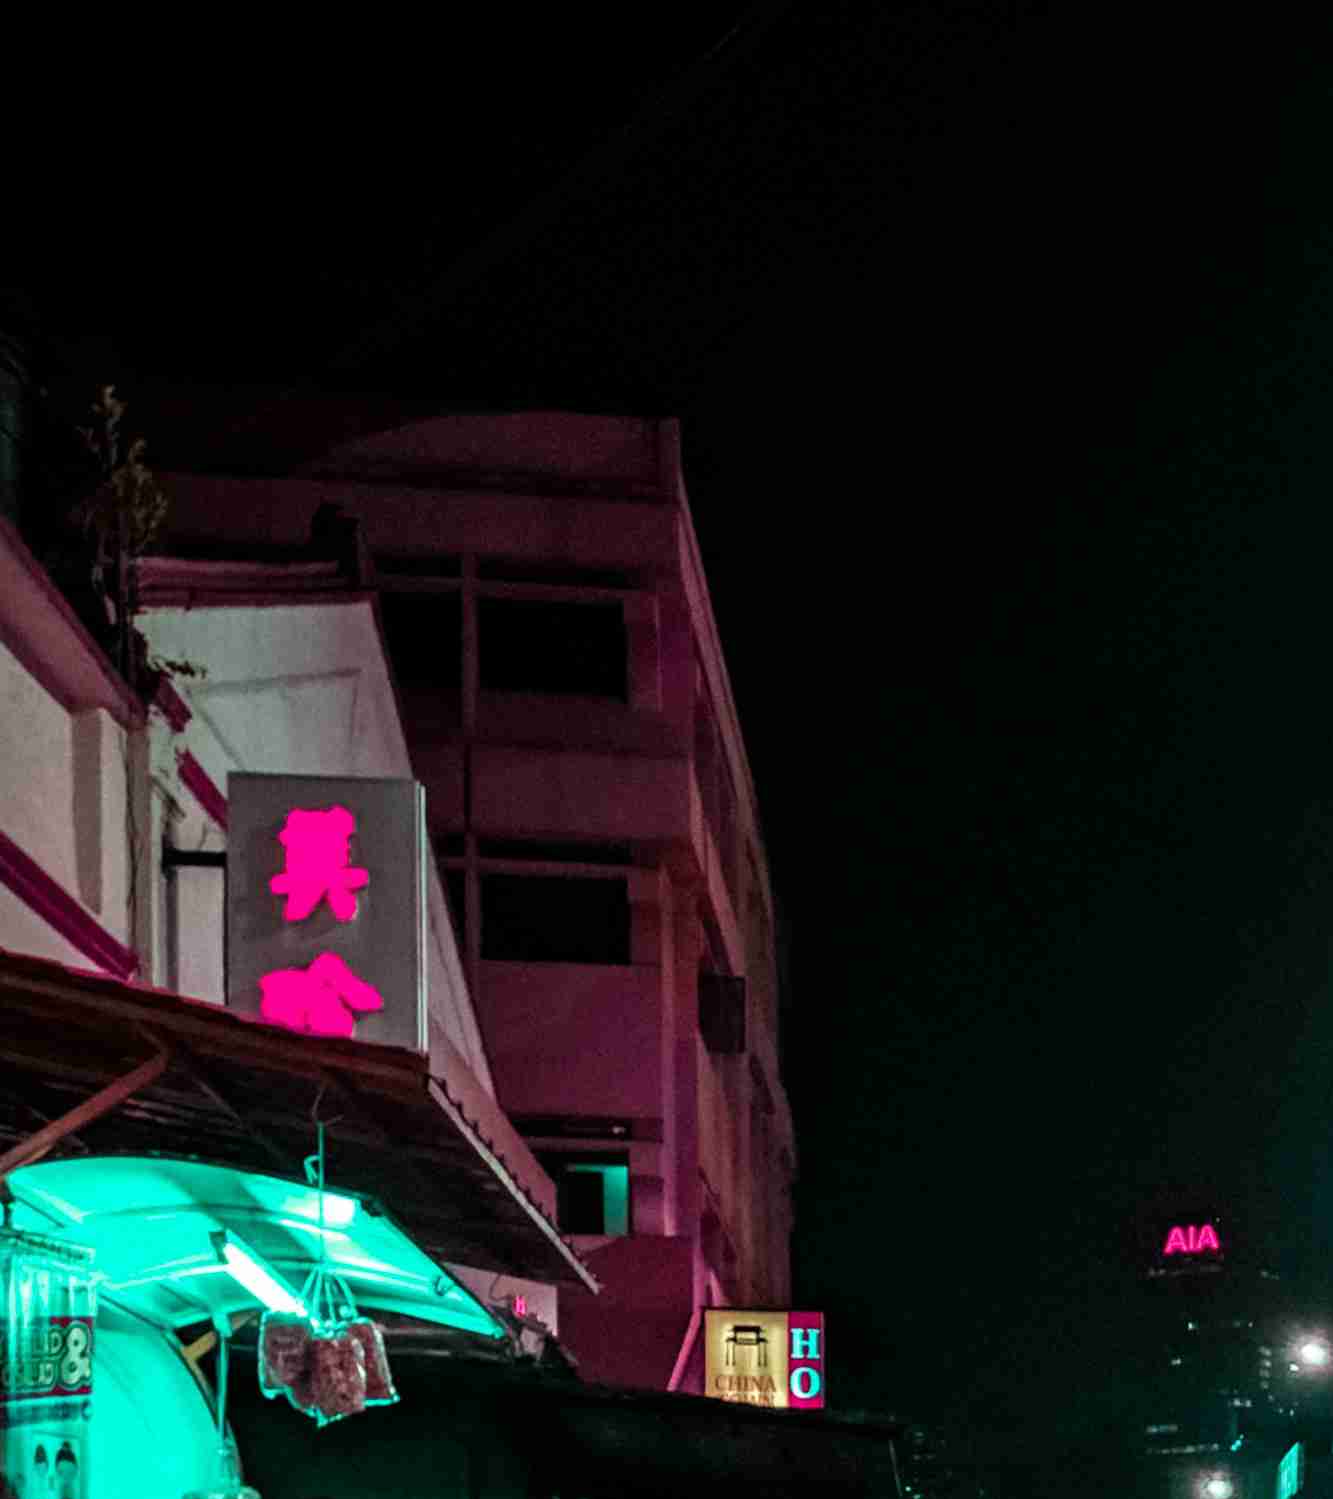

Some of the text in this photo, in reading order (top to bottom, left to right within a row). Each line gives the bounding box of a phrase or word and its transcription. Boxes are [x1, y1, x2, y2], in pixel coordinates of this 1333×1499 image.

[1164, 1224, 1219, 1255] AIA
[790, 1328, 820, 1399] HO
[715, 1375, 777, 1392] CHINA
